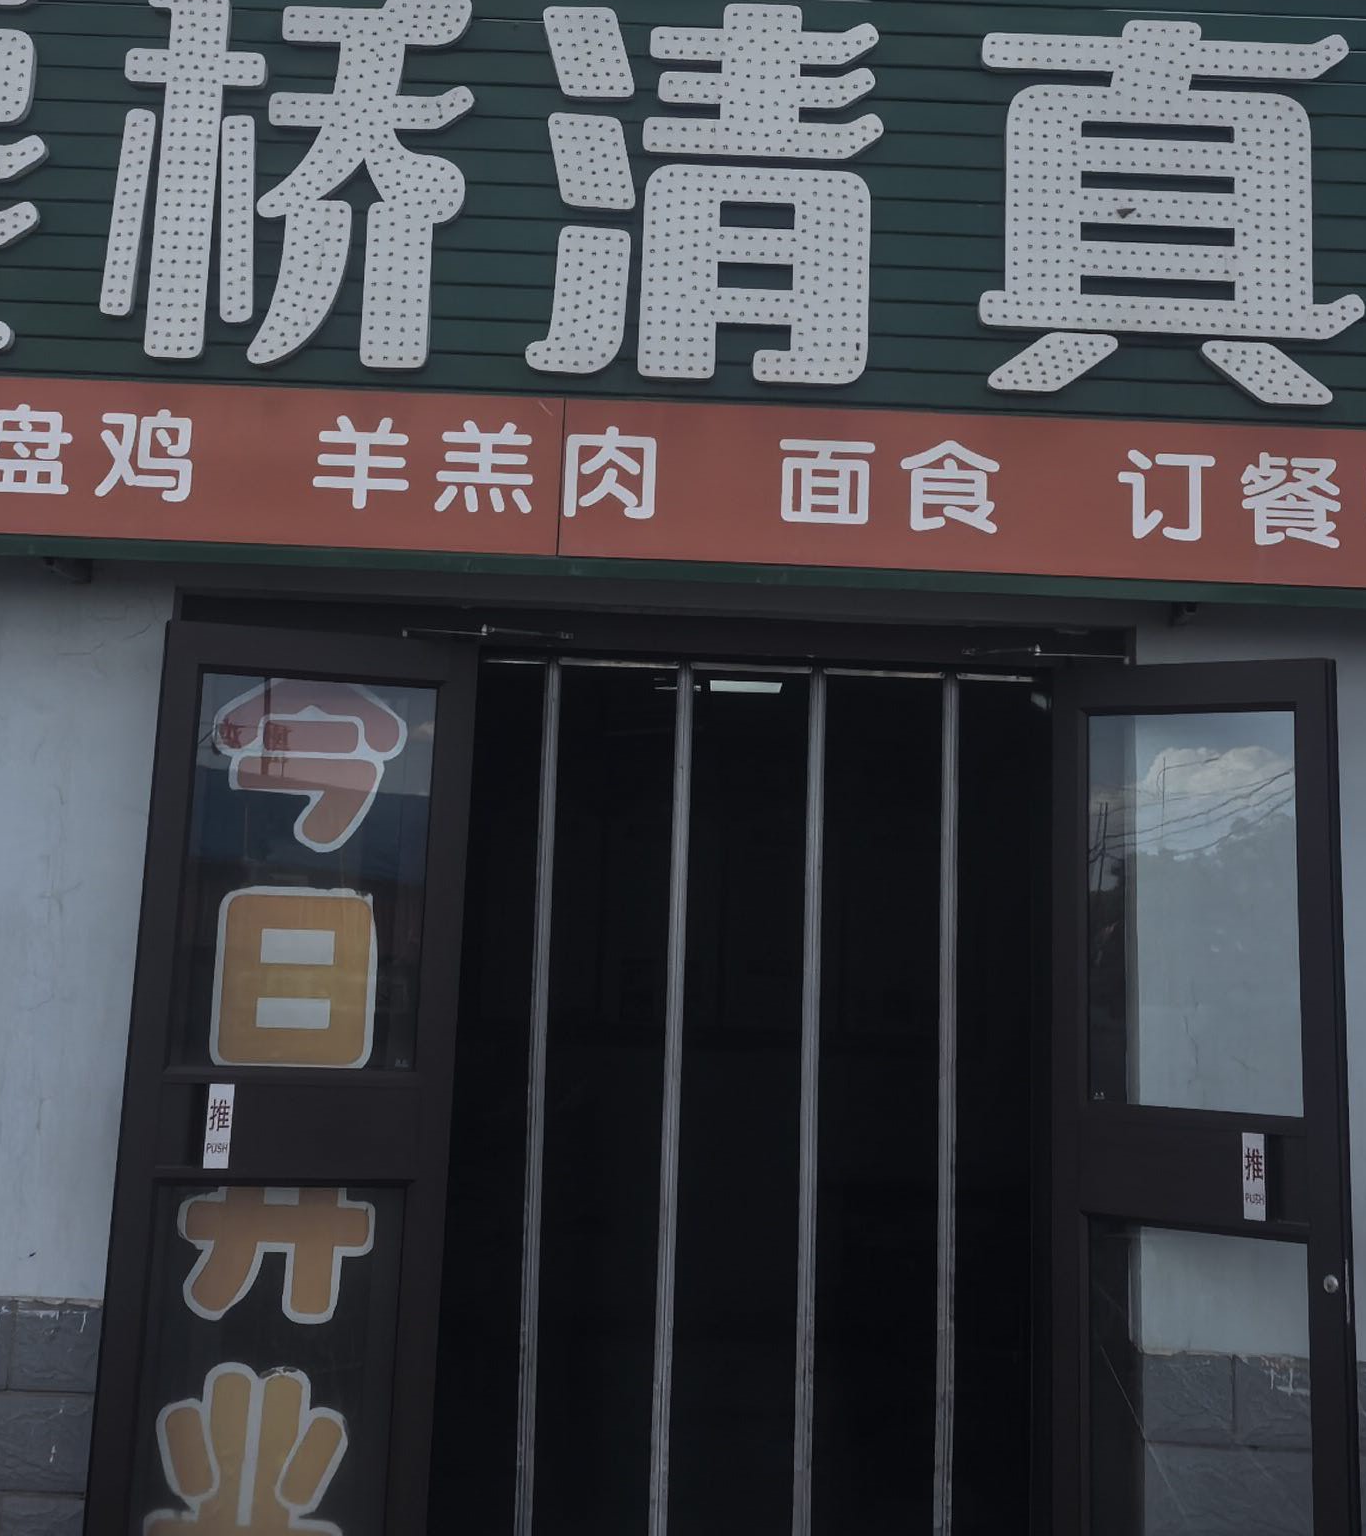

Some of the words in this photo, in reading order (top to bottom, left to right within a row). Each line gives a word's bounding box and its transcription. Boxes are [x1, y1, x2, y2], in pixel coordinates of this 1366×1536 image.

[312, 414, 659, 520] 羊羔肉
[779, 437, 1000, 535] 面食
[208, 1099, 231, 1132] 推
[1244, 1148, 1264, 1182] 推
